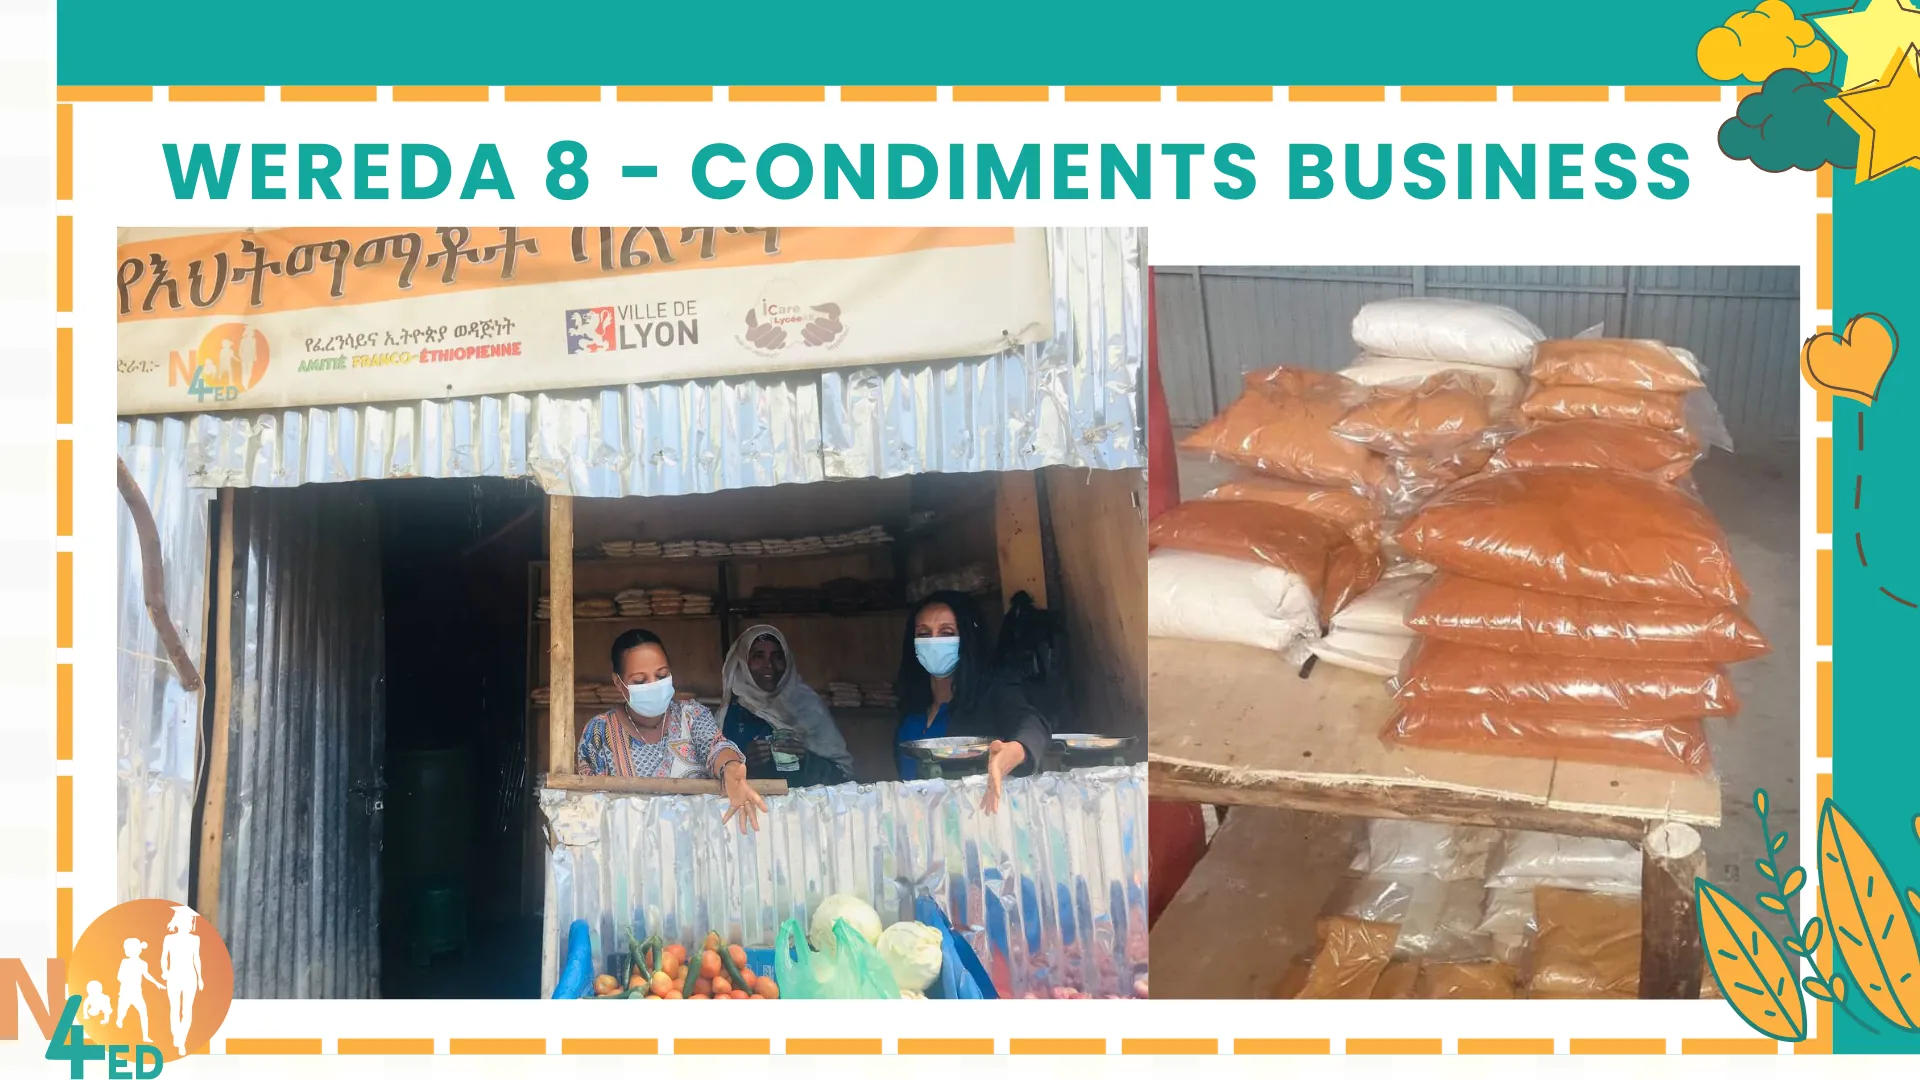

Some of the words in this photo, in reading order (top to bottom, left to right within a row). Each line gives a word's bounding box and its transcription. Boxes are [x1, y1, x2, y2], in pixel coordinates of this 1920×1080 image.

[617, 302, 668, 321] VILLE
[674, 300, 698, 316] DE
[619, 319, 699, 351] LYON
[297, 353, 348, 373] AMITIÉ
